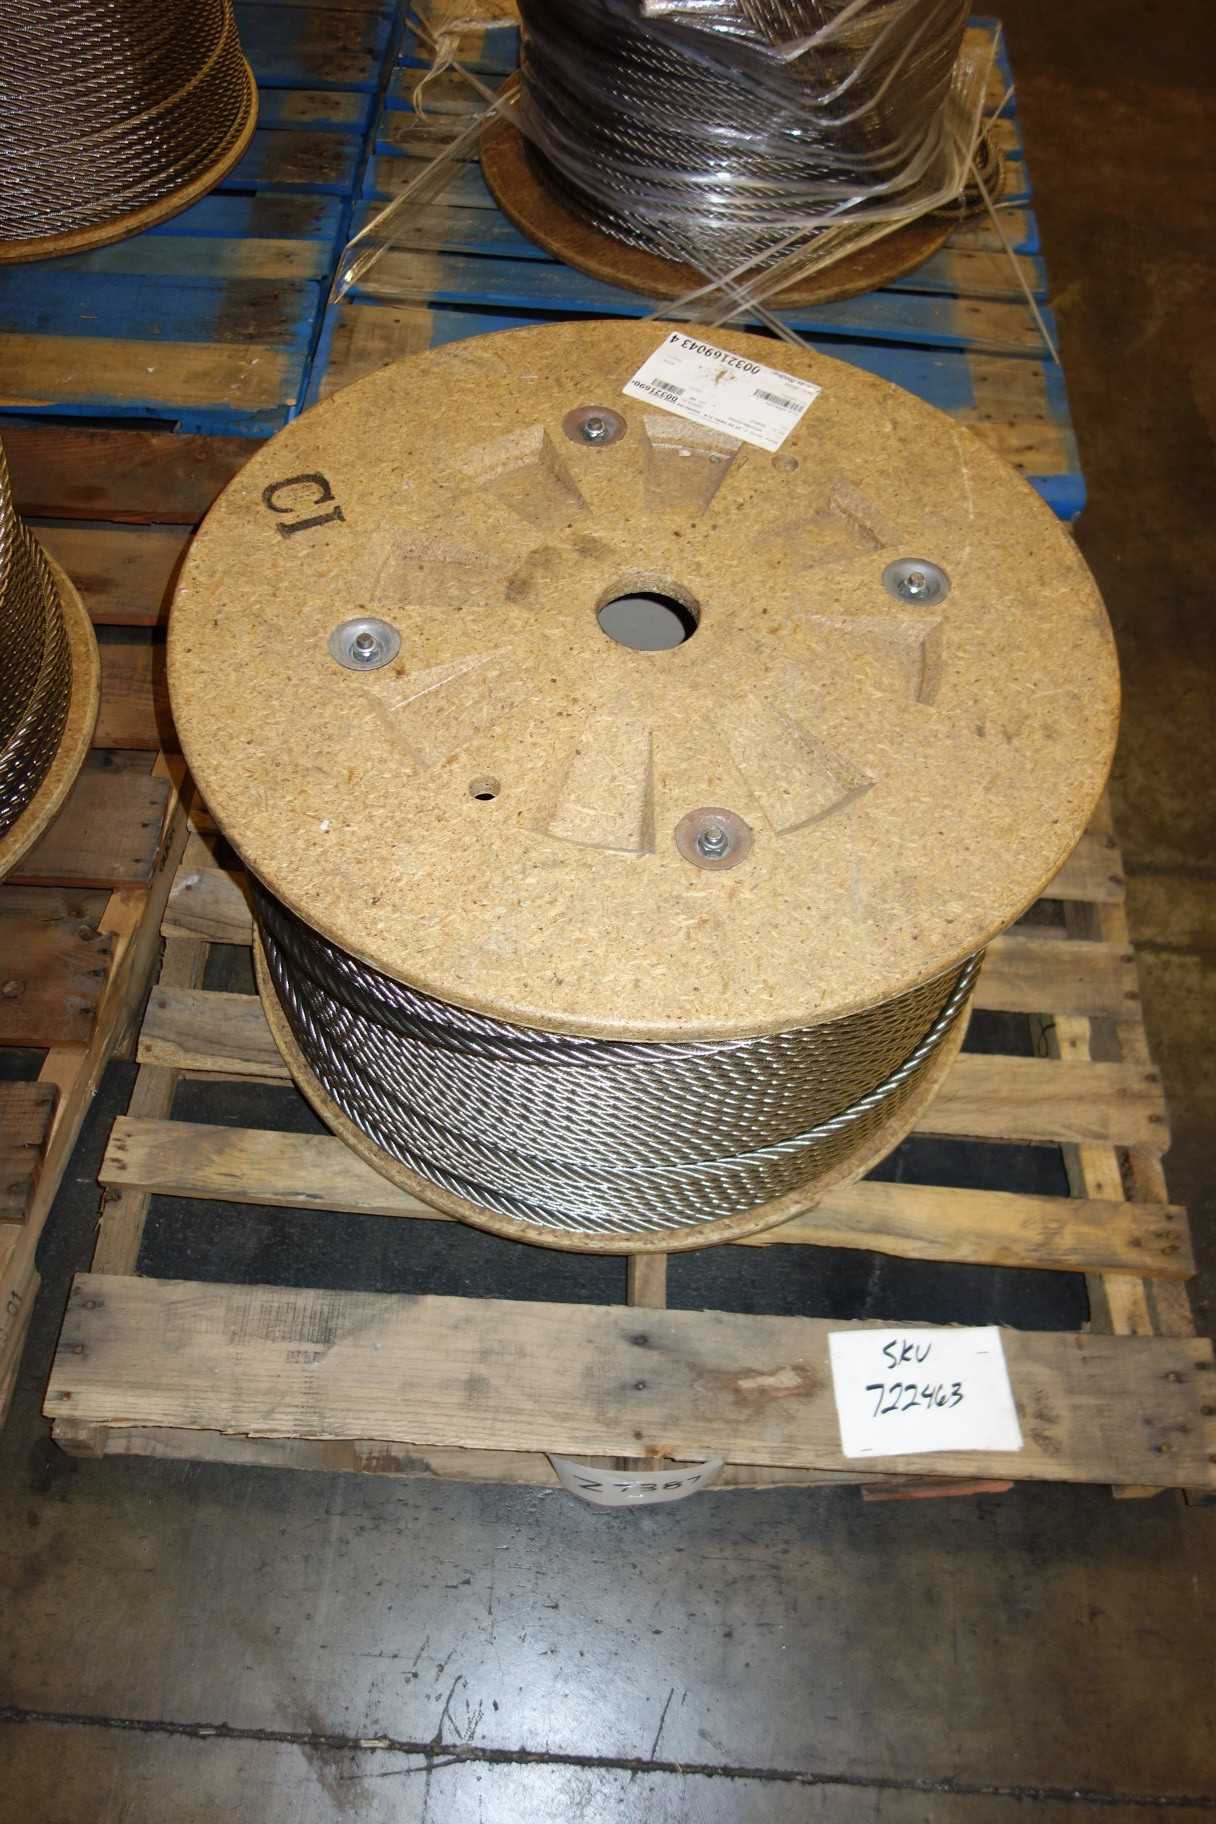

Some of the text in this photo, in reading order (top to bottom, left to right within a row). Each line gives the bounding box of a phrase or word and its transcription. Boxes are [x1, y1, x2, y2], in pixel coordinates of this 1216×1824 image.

[669, 334, 680, 344] 4
[680, 338, 761, 375] 0032169043
[882, 1339, 931, 1369] SKU
[865, 1381, 964, 1418] 722463
